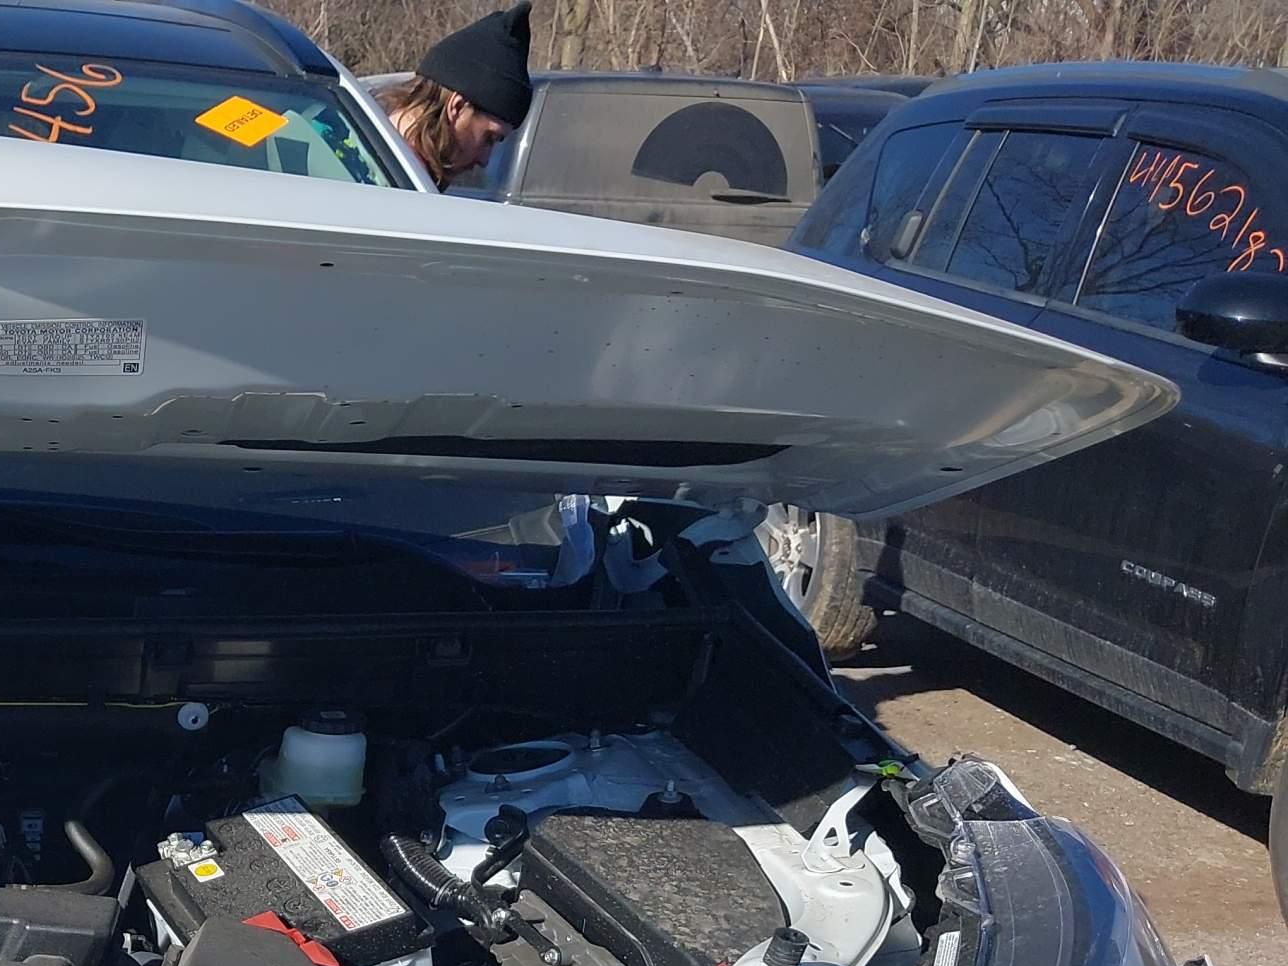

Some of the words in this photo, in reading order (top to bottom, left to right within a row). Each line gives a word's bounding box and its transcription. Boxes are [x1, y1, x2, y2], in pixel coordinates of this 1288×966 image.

[75, 327, 138, 335] CORPORATION
[124, 364, 138, 372] EN
[1120, 559, 1217, 606] COMPASS
